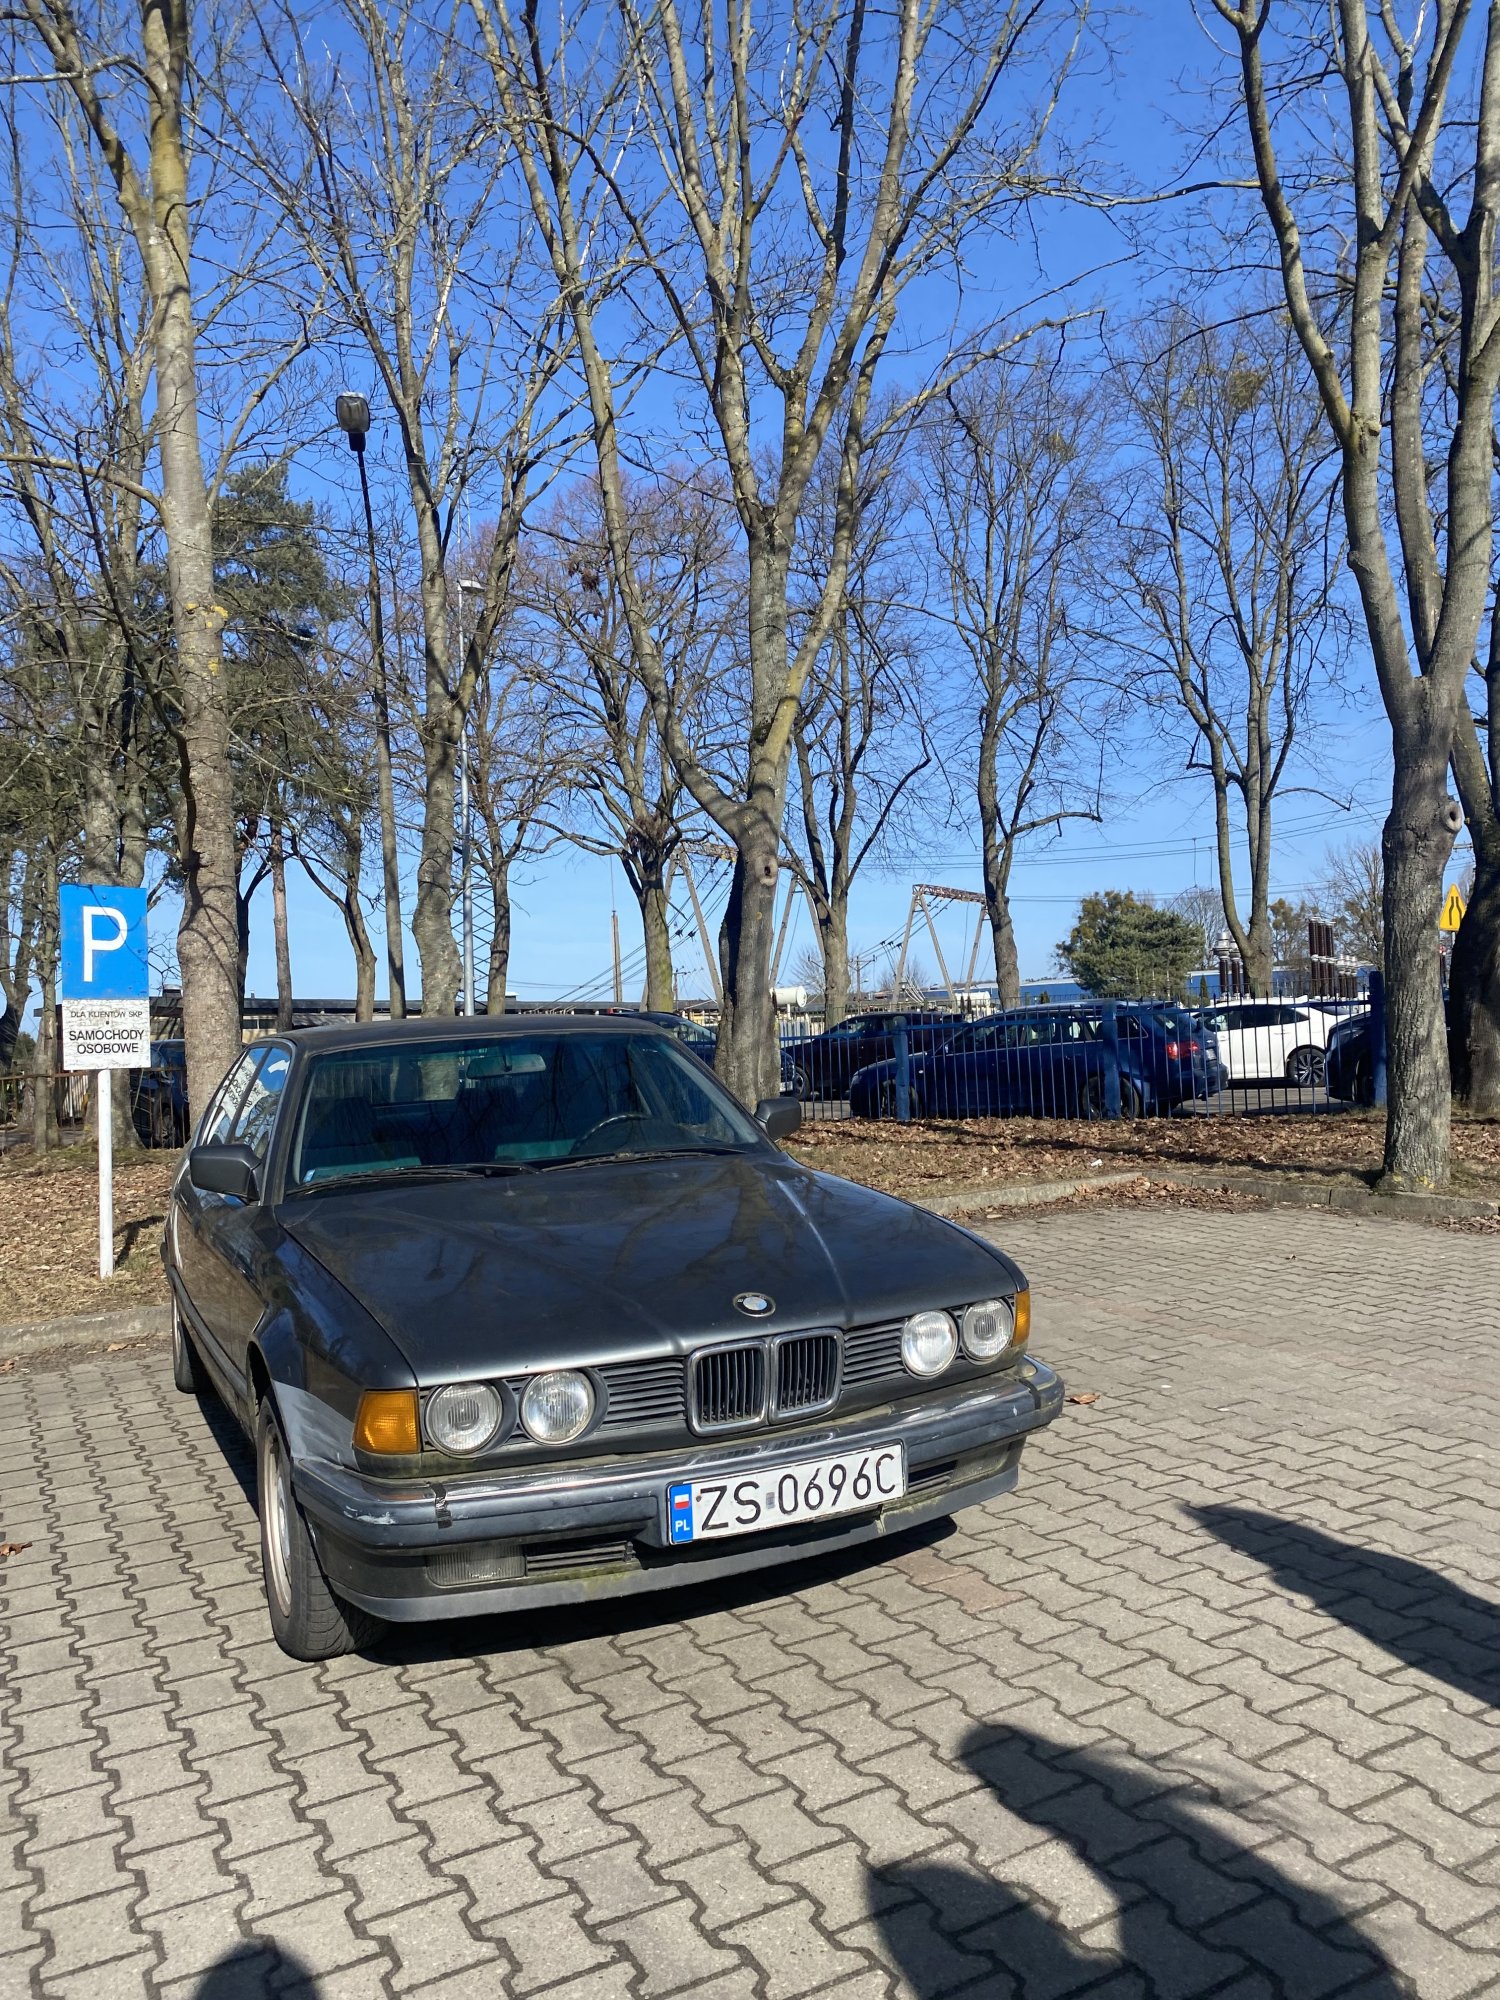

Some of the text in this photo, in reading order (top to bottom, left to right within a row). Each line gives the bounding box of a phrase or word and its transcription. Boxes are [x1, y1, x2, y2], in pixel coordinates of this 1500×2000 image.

[83, 905, 128, 983] P
[70, 1010, 86, 1018] DLA
[128, 1010, 143, 1018] SKP
[69, 1029, 145, 1041] SAMOCHODY
[77, 1042, 139, 1054] OSOBOWE
[700, 1453, 897, 1531] ZS 0696C
[675, 1519, 690, 1533] PL
